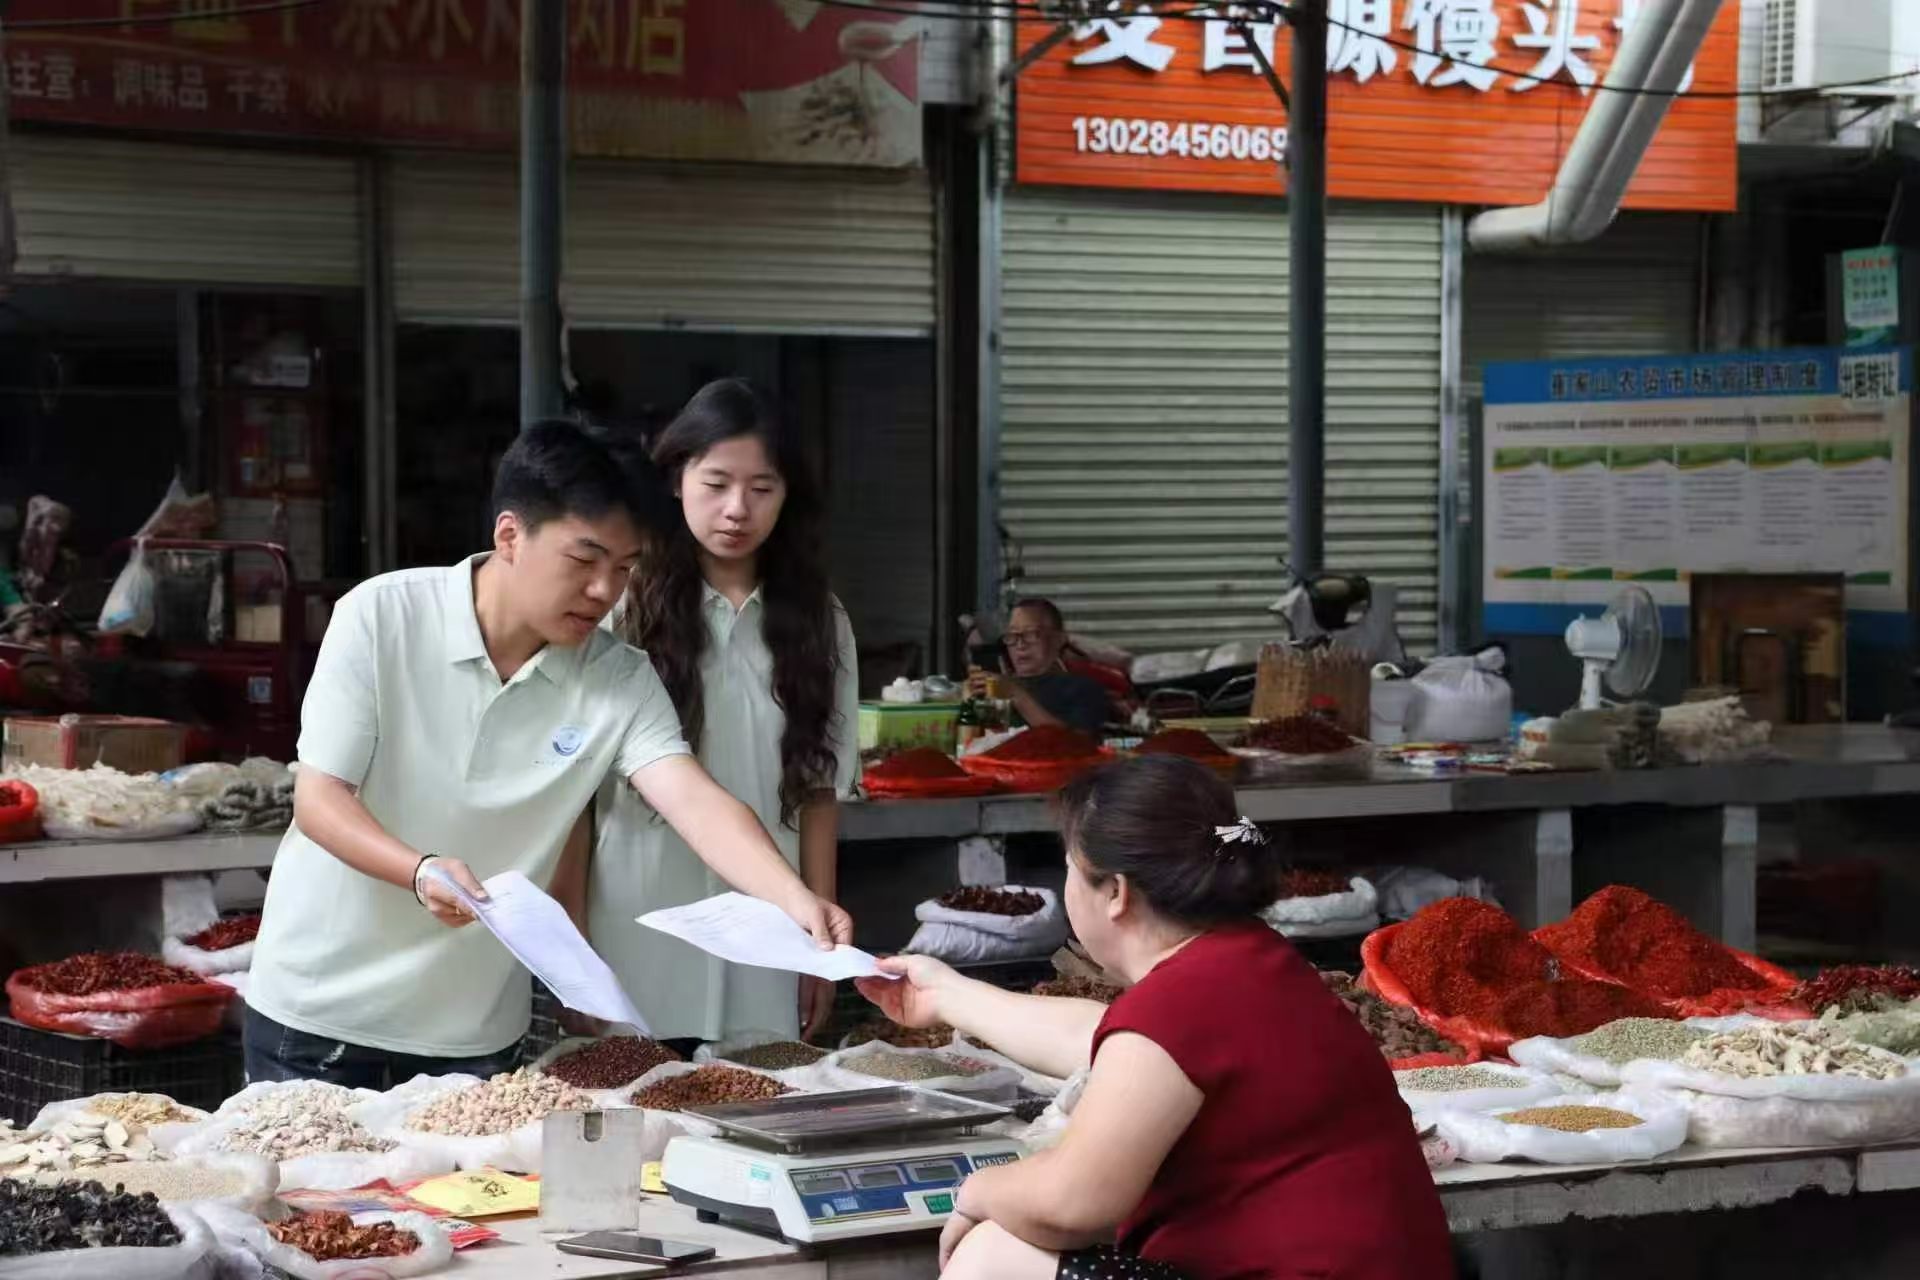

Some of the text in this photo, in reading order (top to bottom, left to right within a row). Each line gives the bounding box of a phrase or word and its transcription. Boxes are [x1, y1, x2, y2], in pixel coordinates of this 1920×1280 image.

[111, 59, 209, 111] 调味品
[1072, 116, 1287, 162] 13028456069
